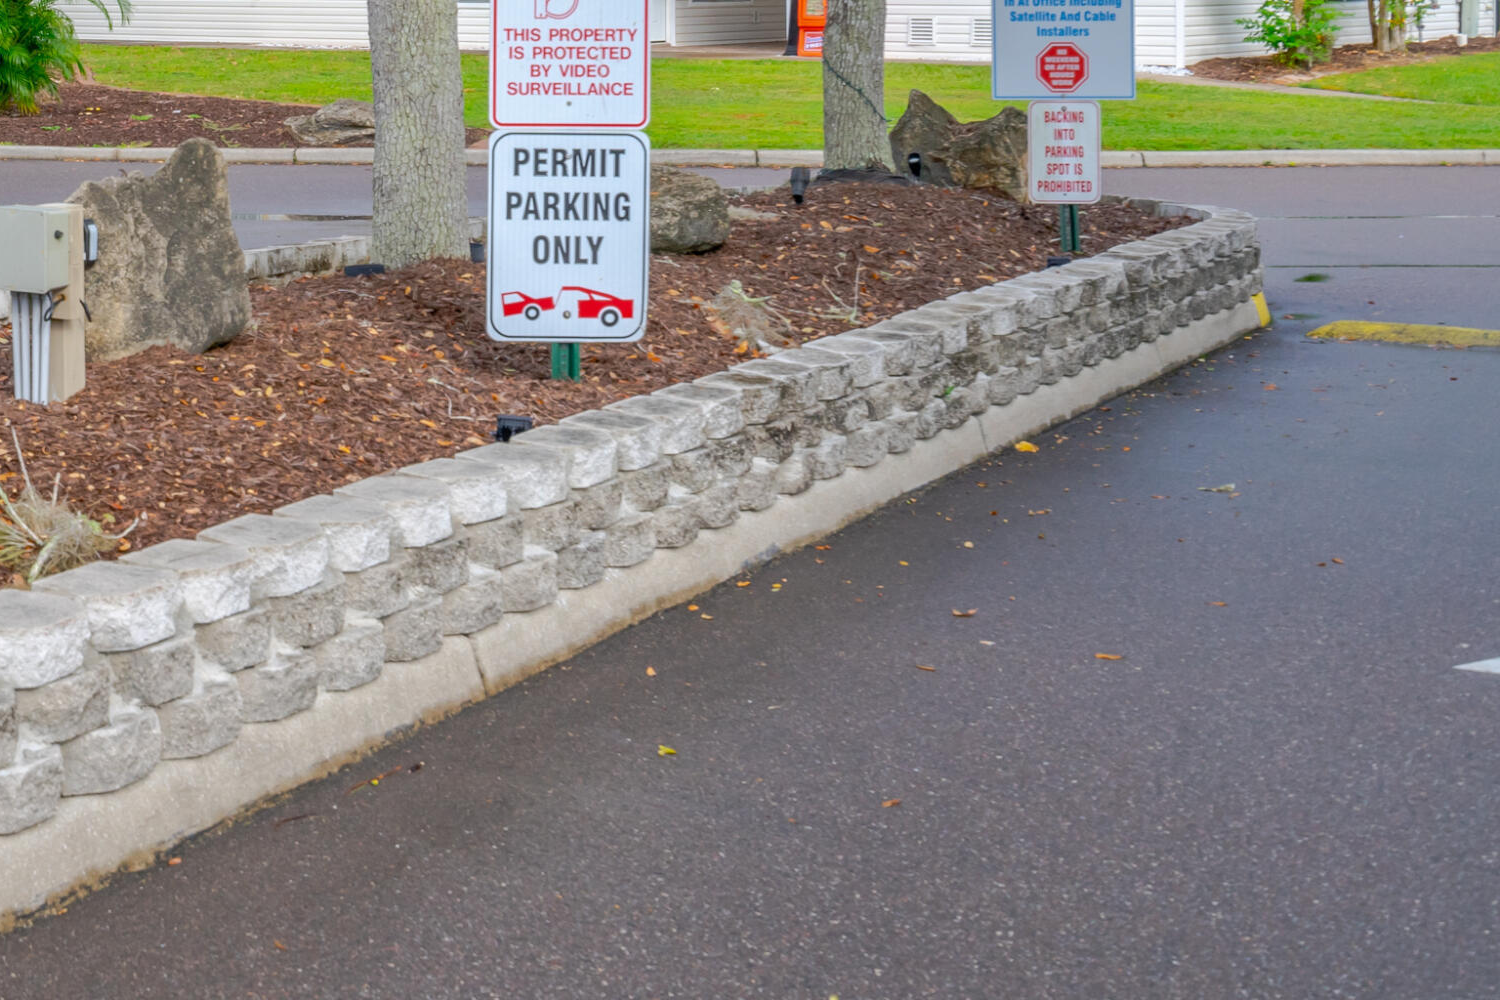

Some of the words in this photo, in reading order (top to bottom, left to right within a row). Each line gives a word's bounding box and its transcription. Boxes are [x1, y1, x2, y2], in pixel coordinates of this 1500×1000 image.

[1009, 11, 1057, 22] Satellite
[1059, 11, 1081, 22] And
[1083, 10, 1117, 22] Cable
[504, 28, 541, 42] THIS
[549, 28, 637, 42] PROPERTY
[1036, 26, 1090, 37] Installers
[509, 46, 525, 60] IS
[532, 46, 632, 60] PROTECTED
[530, 64, 553, 78] BY
[558, 63, 610, 78] VIDEO
[506, 81, 634, 96] SURVEILLANCE
[1044, 111, 1085, 123] BACKING
[1053, 128, 1076, 140] INTO
[1044, 145, 1085, 158] PARKING
[513, 147, 627, 178] PERMIT
[1046, 163, 1070, 175] SPOT
[1073, 163, 1083, 175] IS
[1036, 180, 1093, 193] PROHIBITED
[505, 191, 632, 222] PARKING
[532, 235, 605, 265] ONLY
